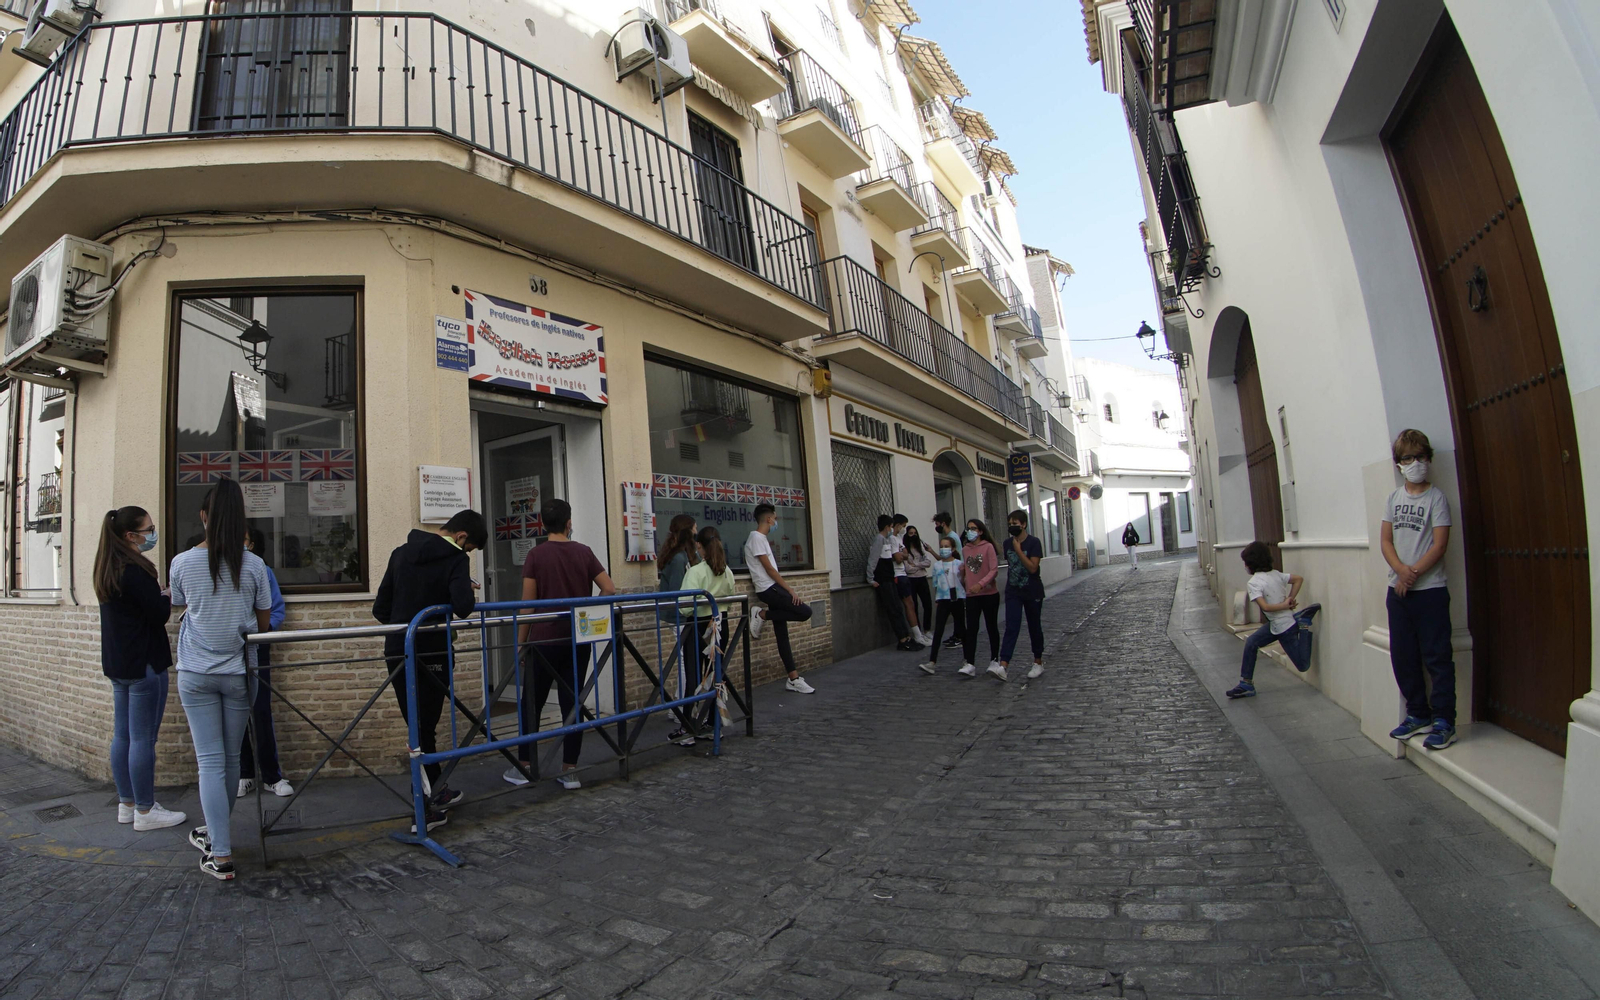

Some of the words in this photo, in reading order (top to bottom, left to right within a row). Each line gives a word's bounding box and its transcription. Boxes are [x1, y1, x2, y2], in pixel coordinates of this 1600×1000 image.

[438, 319, 460, 330] tyco
[489, 308, 530, 327] Profesores
[531, 319, 540, 330] de
[541, 321, 561, 335] inglés
[562, 328, 585, 341] nativos
[438, 341, 460, 350] Alarma
[477, 319, 543, 369] English
[547, 349, 597, 370] House
[496, 365, 544, 383] Academia
[547, 375, 557, 385] de
[560, 377, 587, 391] Inglés
[704, 505, 737, 525] English
[1394, 505, 1424, 517] POLO
